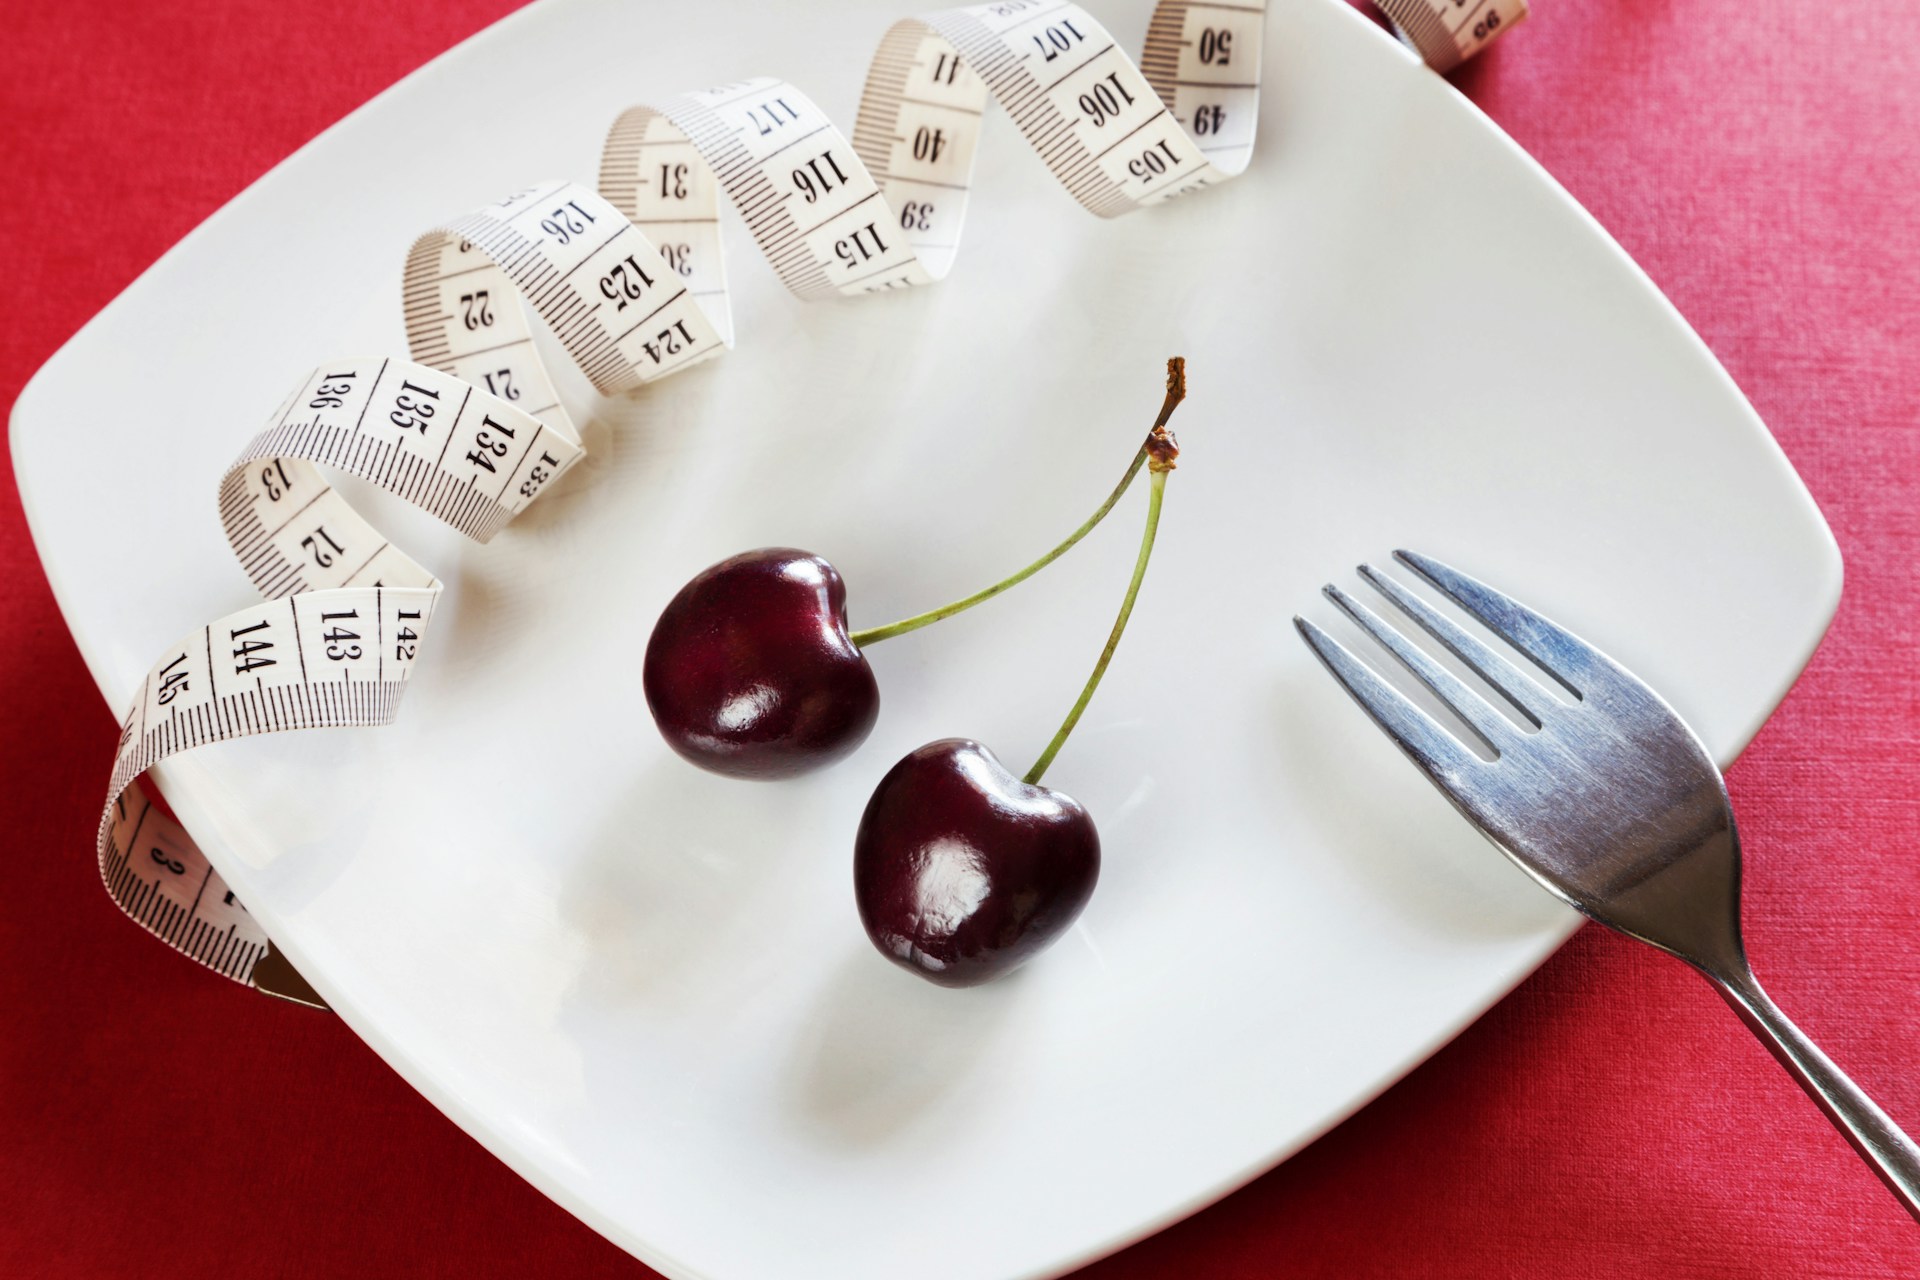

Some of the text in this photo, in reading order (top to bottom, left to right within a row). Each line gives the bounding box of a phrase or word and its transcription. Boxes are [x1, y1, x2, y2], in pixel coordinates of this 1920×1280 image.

[1033, 19, 1085, 62] 107
[1200, 27, 1232, 66] 50
[747, 98, 800, 136] 117
[1078, 71, 1136, 128] 106
[1194, 104, 1227, 137] 49
[913, 126, 947, 164] 40
[1128, 138, 1184, 184] 105
[660, 164, 689, 200] 31
[791, 150, 849, 205] 116
[541, 200, 598, 246] 126
[900, 200, 936, 232] 39
[660, 243, 692, 277] 30
[834, 221, 890, 270] 115
[600, 254, 656, 313] 125
[460, 290, 495, 332] 22
[642, 319, 697, 366] 124
[309, 371, 357, 409] 136
[482, 368, 520, 401] 21
[390, 379, 441, 436] 135
[465, 413, 516, 475] 134
[261, 457, 292, 502] 13
[519, 450, 561, 499] 133
[300, 525, 346, 570] 12
[230, 619, 277, 676] 144
[321, 608, 363, 662] 143
[396, 608, 421, 662] 142
[157, 652, 189, 706] 145
[150, 847, 186, 876] 3
